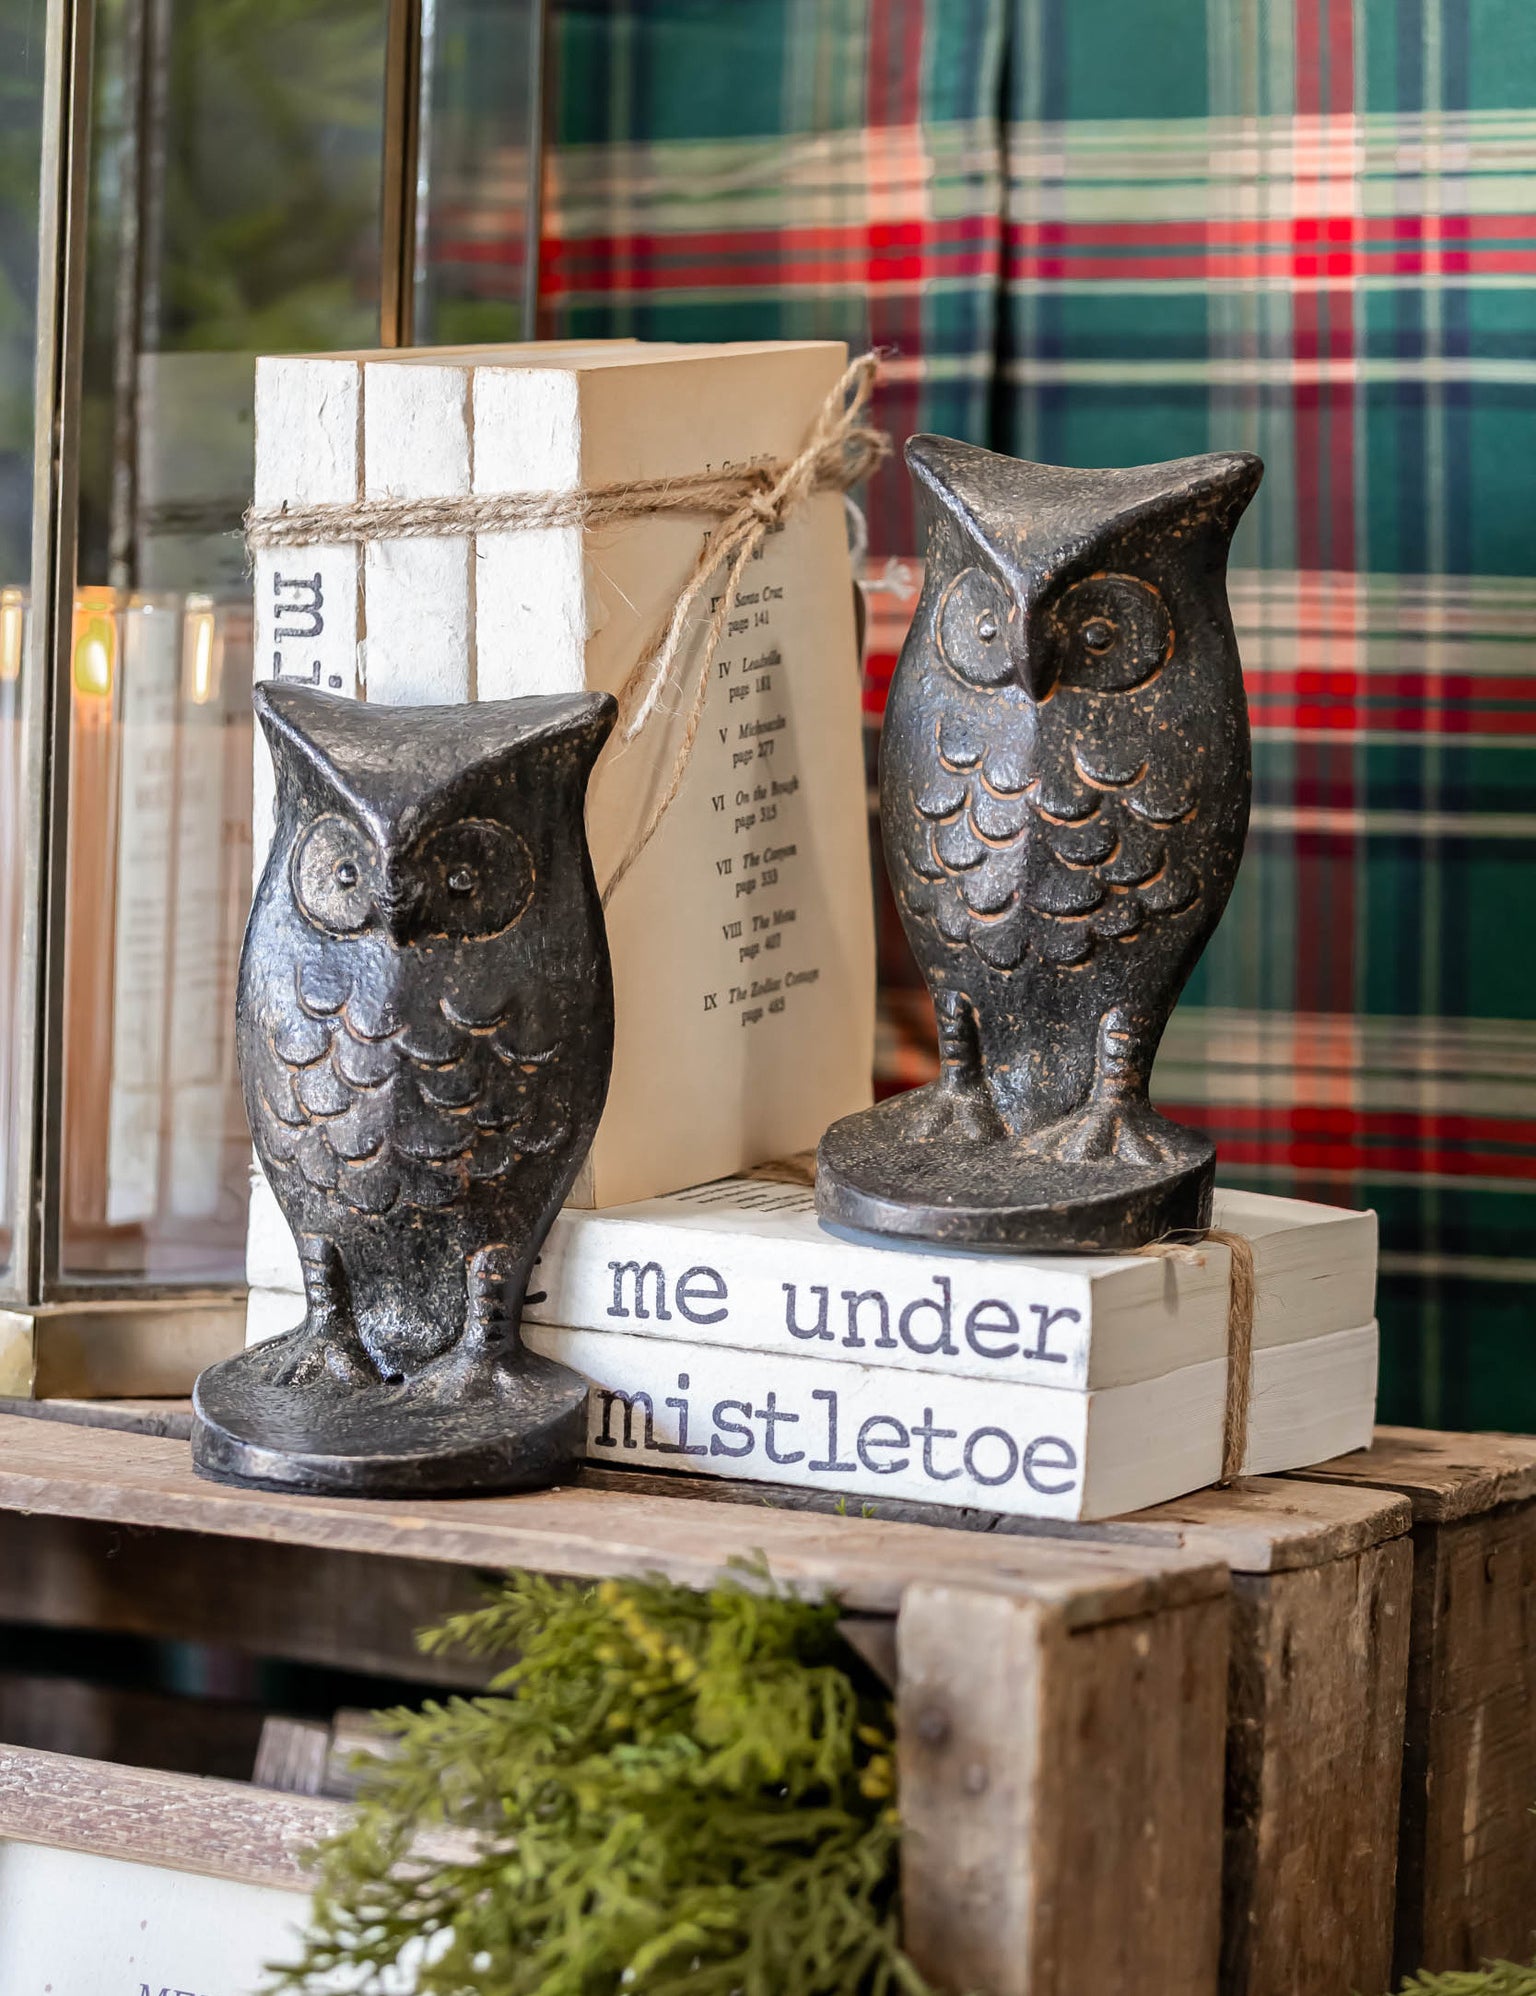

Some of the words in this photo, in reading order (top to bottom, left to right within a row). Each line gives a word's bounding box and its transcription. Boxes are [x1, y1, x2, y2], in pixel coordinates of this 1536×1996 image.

[762, 585, 783, 602] Cruz
[728, 618, 749, 637] page
[754, 610, 770, 627] 141
[718, 661, 731, 678] IV
[729, 684, 750, 703] page
[718, 727, 728, 744] V
[732, 748, 753, 769] page
[711, 794, 725, 812] VI
[735, 789, 750, 806] On
[753, 784, 767, 801] the
[734, 812, 756, 834] page
[715, 857, 732, 876] VII
[743, 851, 761, 869] The
[735, 877, 757, 899] page
[722, 920, 742, 941] VIII
[752, 914, 770, 932] The
[739, 942, 760, 963] page
[703, 992, 718, 1011] IX
[728, 986, 748, 1004] The
[741, 1006, 763, 1027] page
[607, 1258, 729, 1325] me
[782, 1275, 1082, 1364] under
[594, 1372, 1079, 1496] mistletoe
